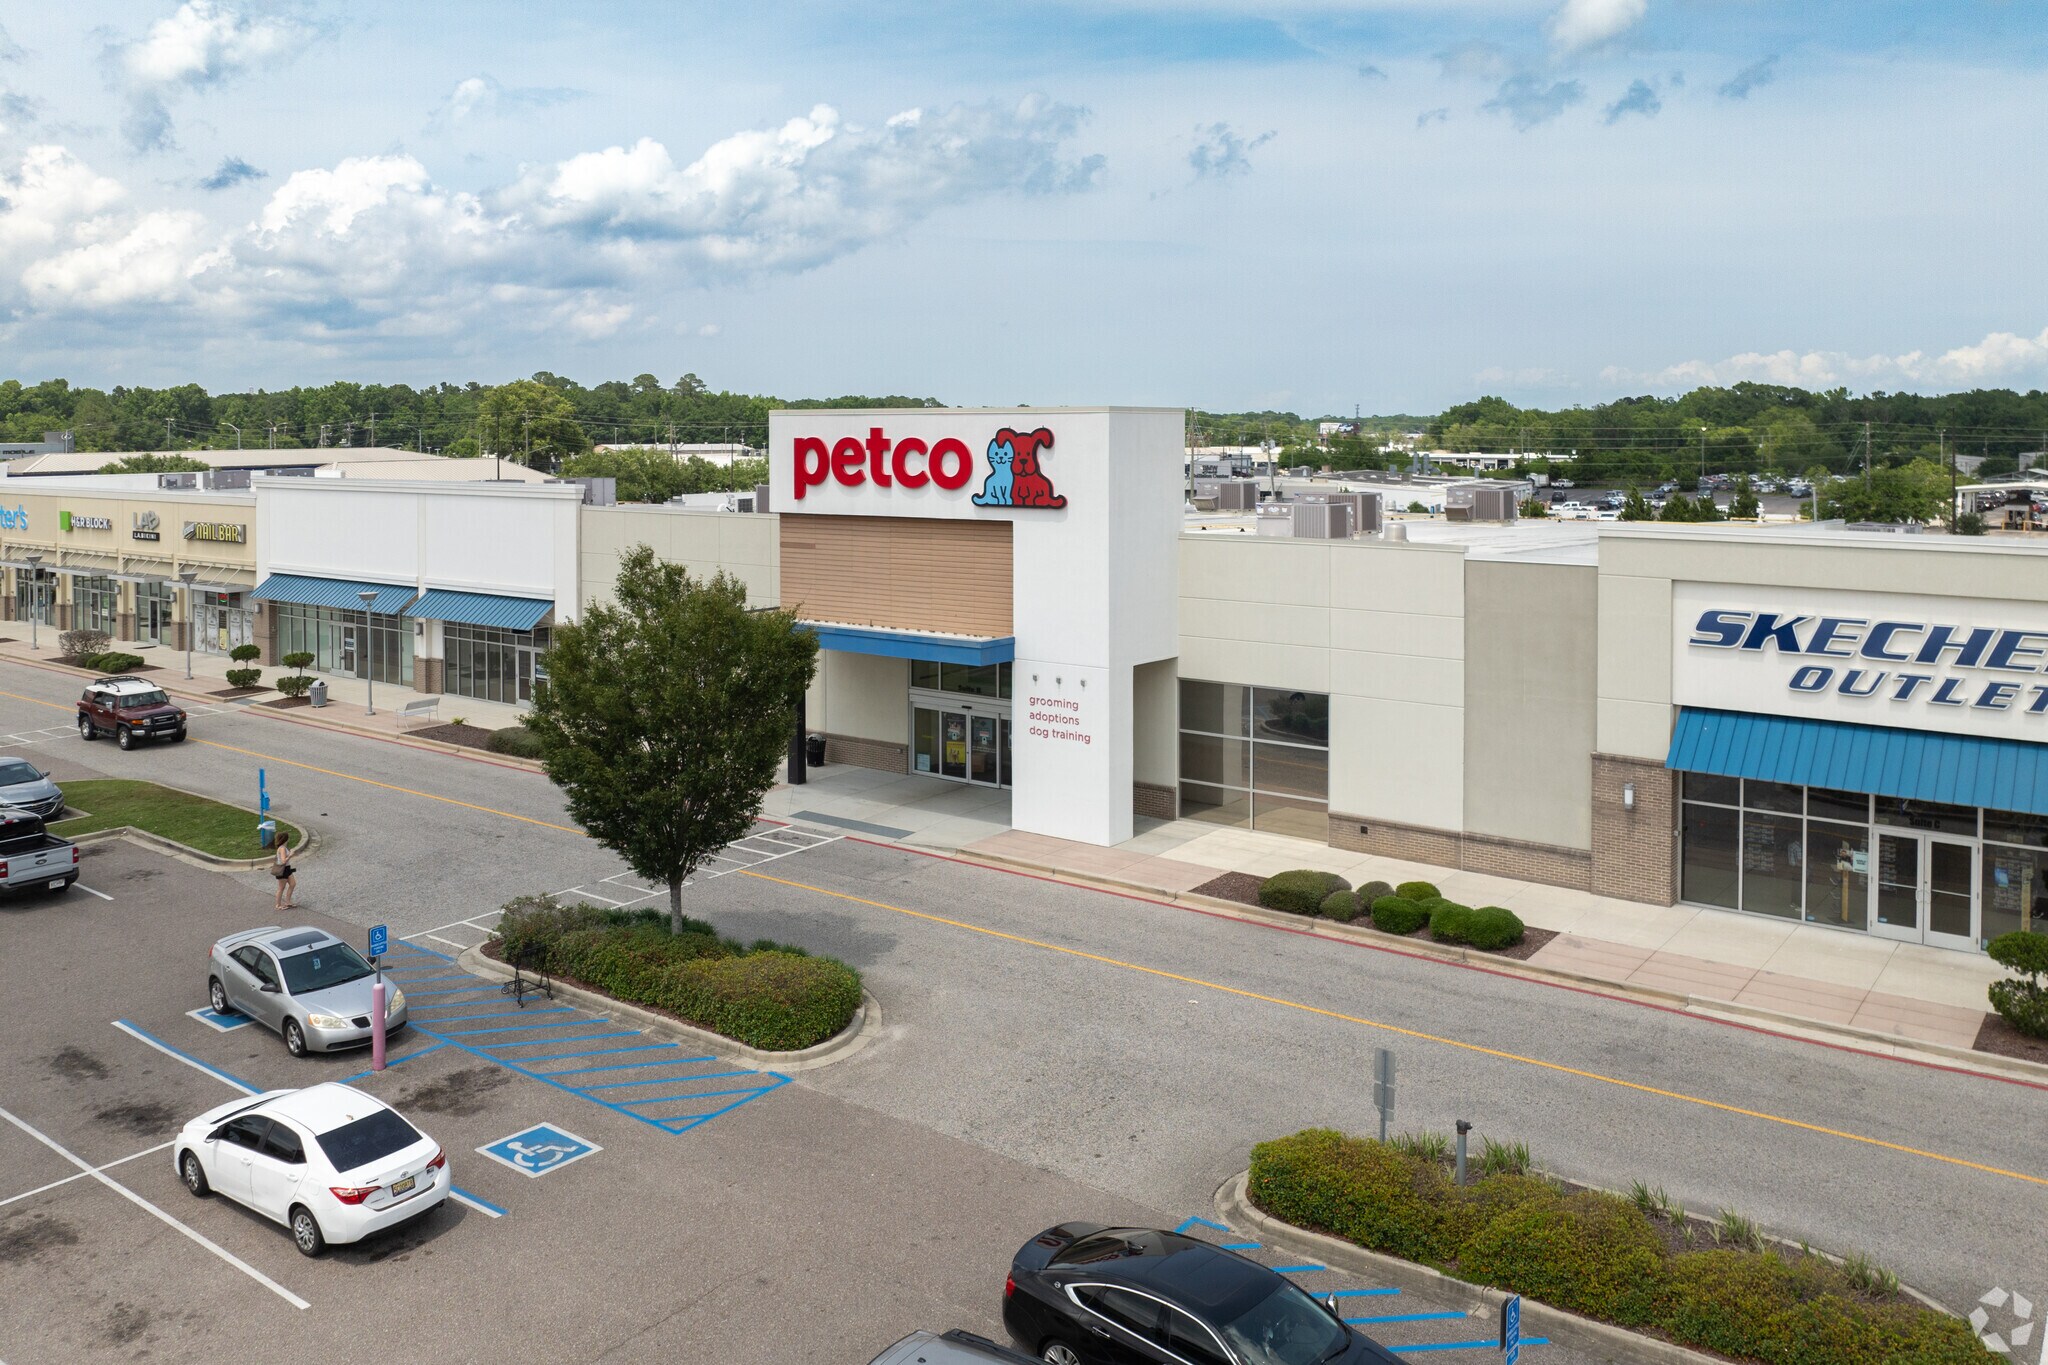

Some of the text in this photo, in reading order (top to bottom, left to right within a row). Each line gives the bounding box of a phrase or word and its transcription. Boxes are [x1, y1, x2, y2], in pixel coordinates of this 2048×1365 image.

[793, 427, 973, 501] petco
[85, 517, 108, 530] BLOCK
[196, 523, 240, 542] NAIL BAR
[1688, 608, 2048, 675] SKECHE
[1029, 696, 1079, 712] grooming
[1029, 711, 1080, 726] adoptions
[1029, 726, 1091, 745] dog training
